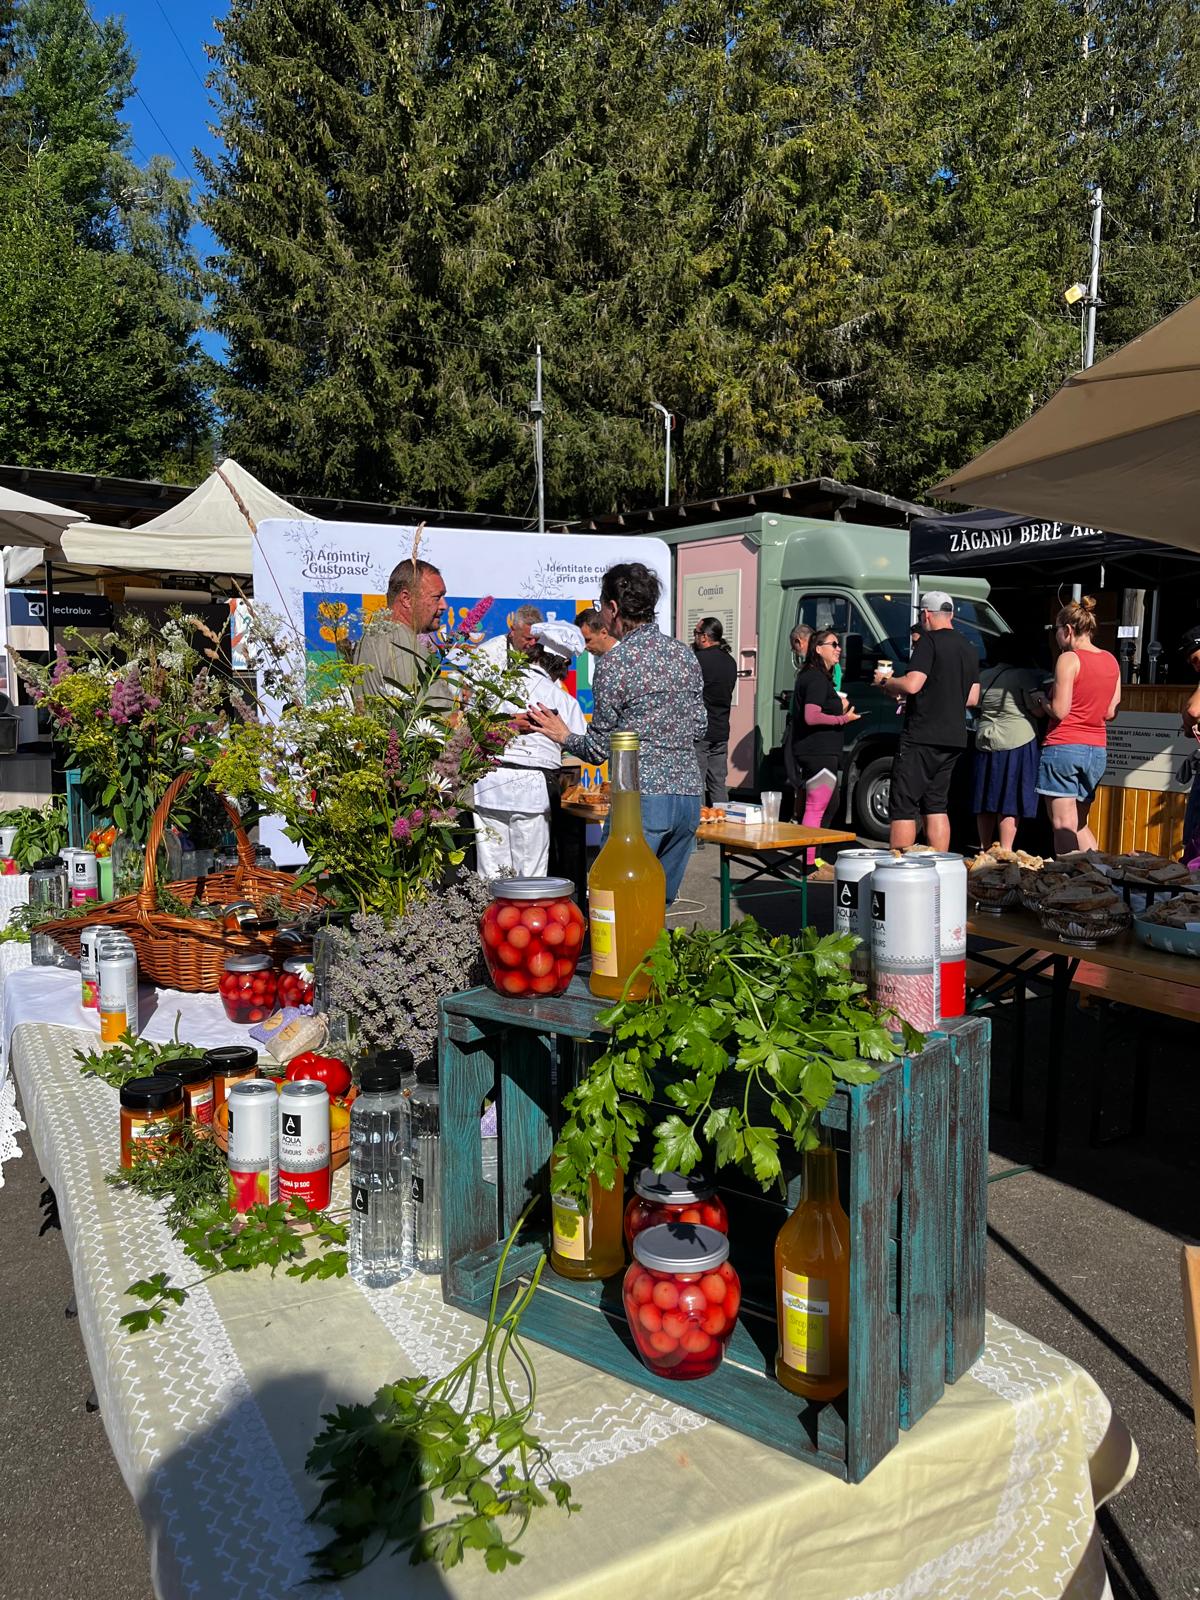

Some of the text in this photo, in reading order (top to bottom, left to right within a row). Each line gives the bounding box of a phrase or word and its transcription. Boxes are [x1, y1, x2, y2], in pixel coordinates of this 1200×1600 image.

[950, 528, 1012, 552] ZĂGANU
[1019, 521, 1063, 544] BERE
[304, 549, 374, 568] Amintiri
[302, 562, 369, 579] Gustoase
[546, 563, 610, 573] Identitate cul
[556, 575, 603, 584] prin gastr
[52, 605, 92, 615] lectrolux
[836, 908, 858, 919] AQUA
[282, 1136, 302, 1145] AQUA
